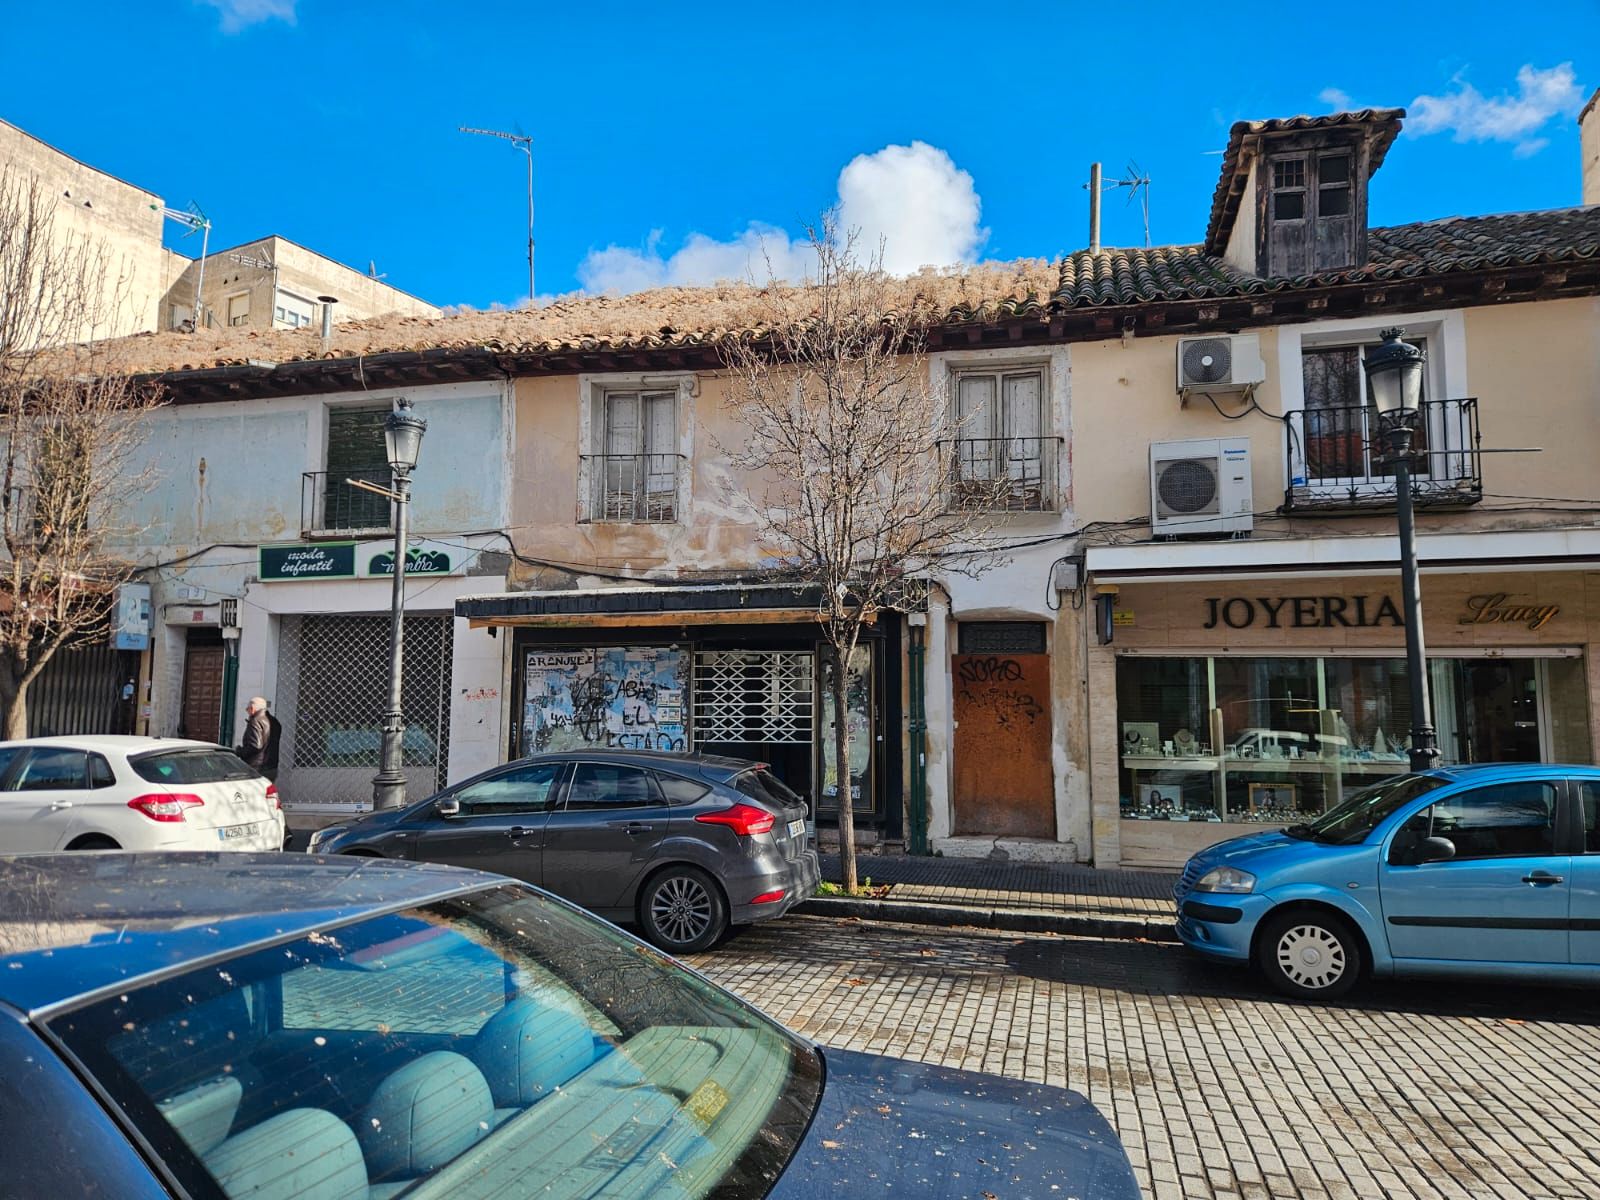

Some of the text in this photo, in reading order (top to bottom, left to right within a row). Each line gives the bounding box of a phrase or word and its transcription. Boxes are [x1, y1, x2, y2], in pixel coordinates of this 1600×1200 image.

[288, 547, 326, 560] moda
[280, 558, 334, 577] infantil
[1203, 593, 1560, 630] JOYERIA Lucy
